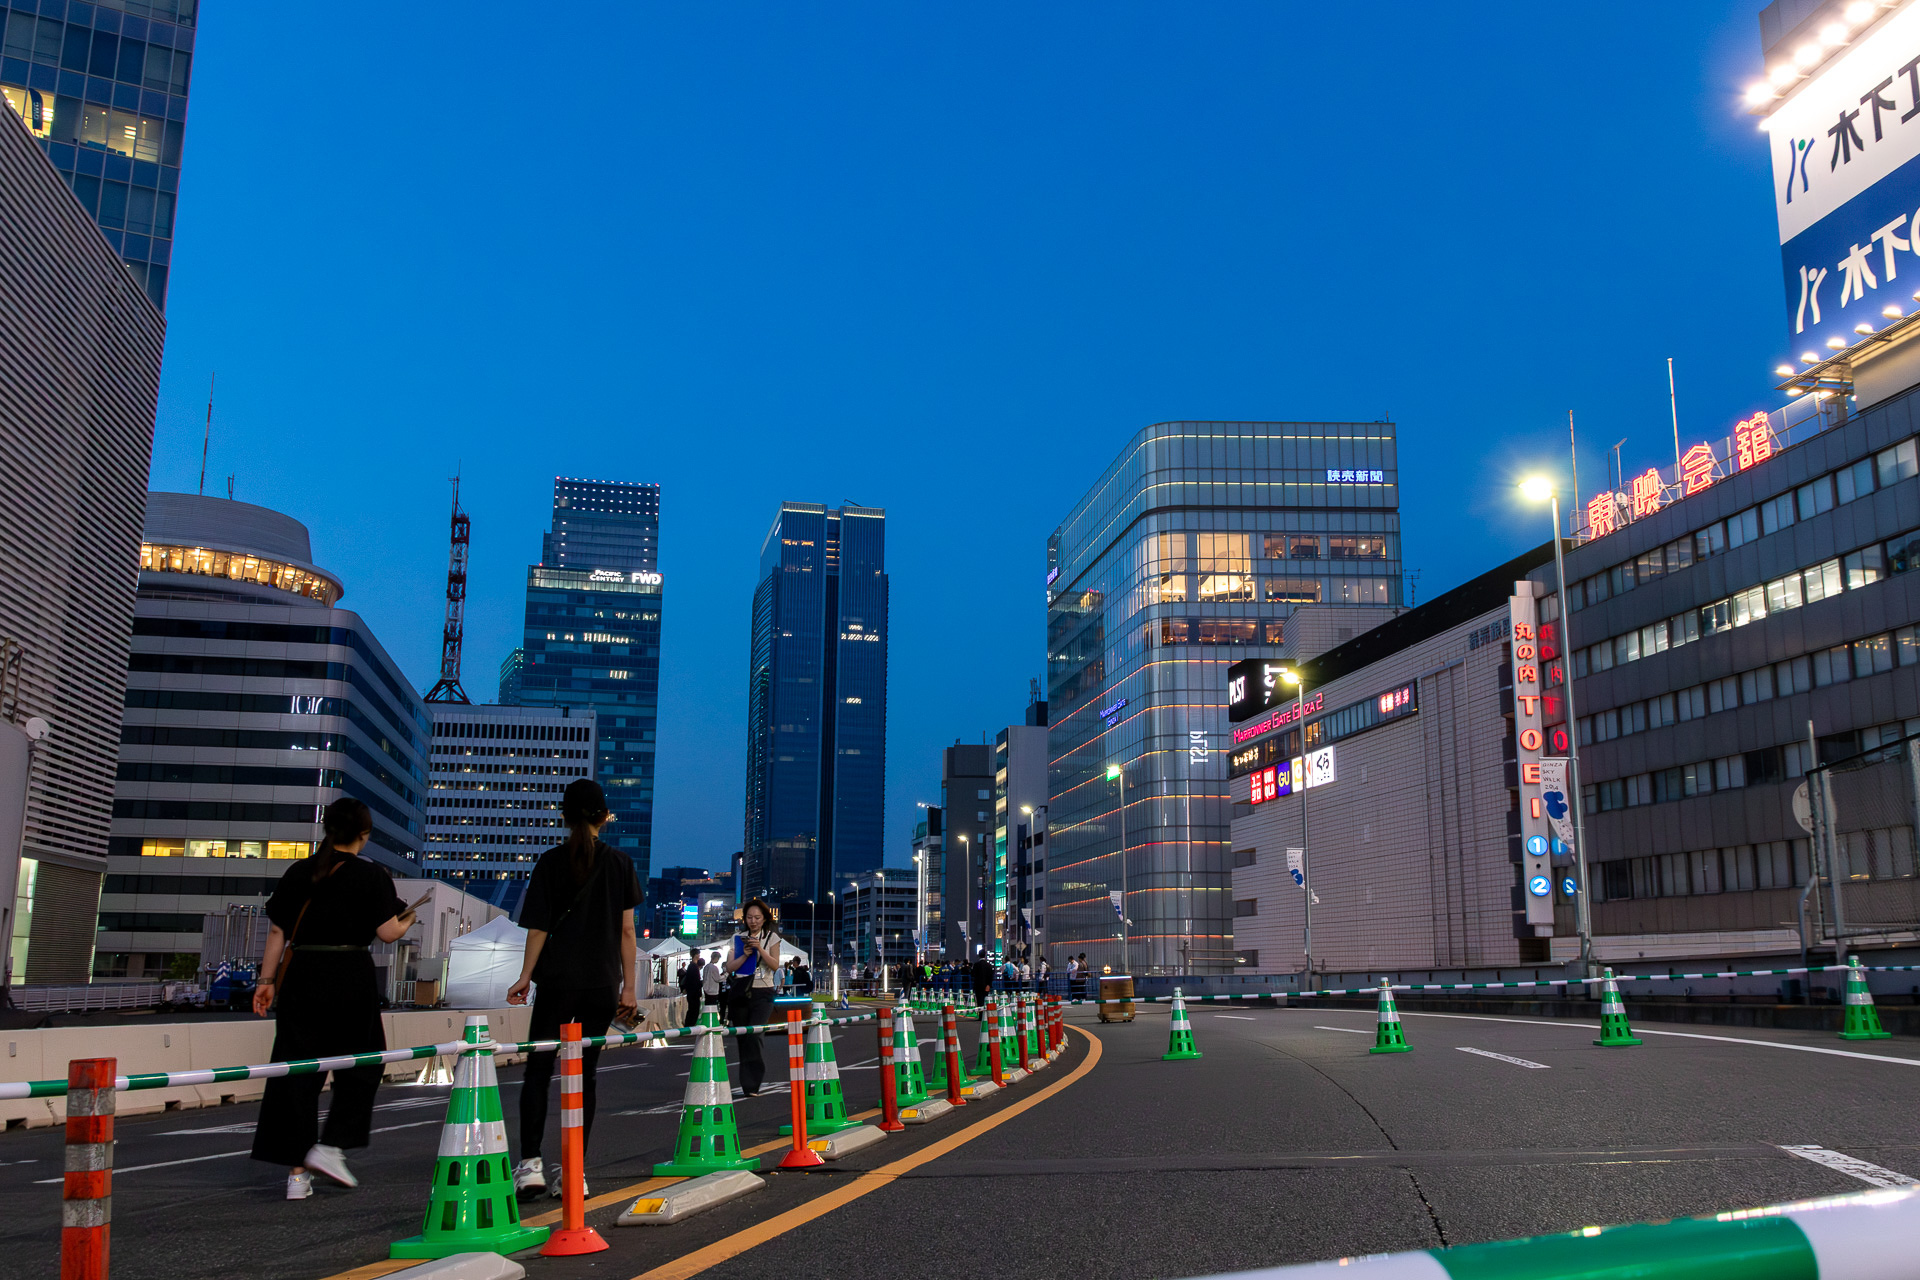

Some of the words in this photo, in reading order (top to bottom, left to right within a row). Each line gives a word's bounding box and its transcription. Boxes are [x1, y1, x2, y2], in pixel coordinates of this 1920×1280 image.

[1327, 470, 1383, 482] 読売新聞
[632, 573, 661, 584] FWD
[1229, 676, 1245, 705] PLST
[1272, 711, 1291, 728] GATE
[1316, 692, 1324, 711] 2
[1264, 769, 1274, 784] UNI
[1278, 771, 1290, 787] GU
[1264, 783, 1275, 799] QLO
